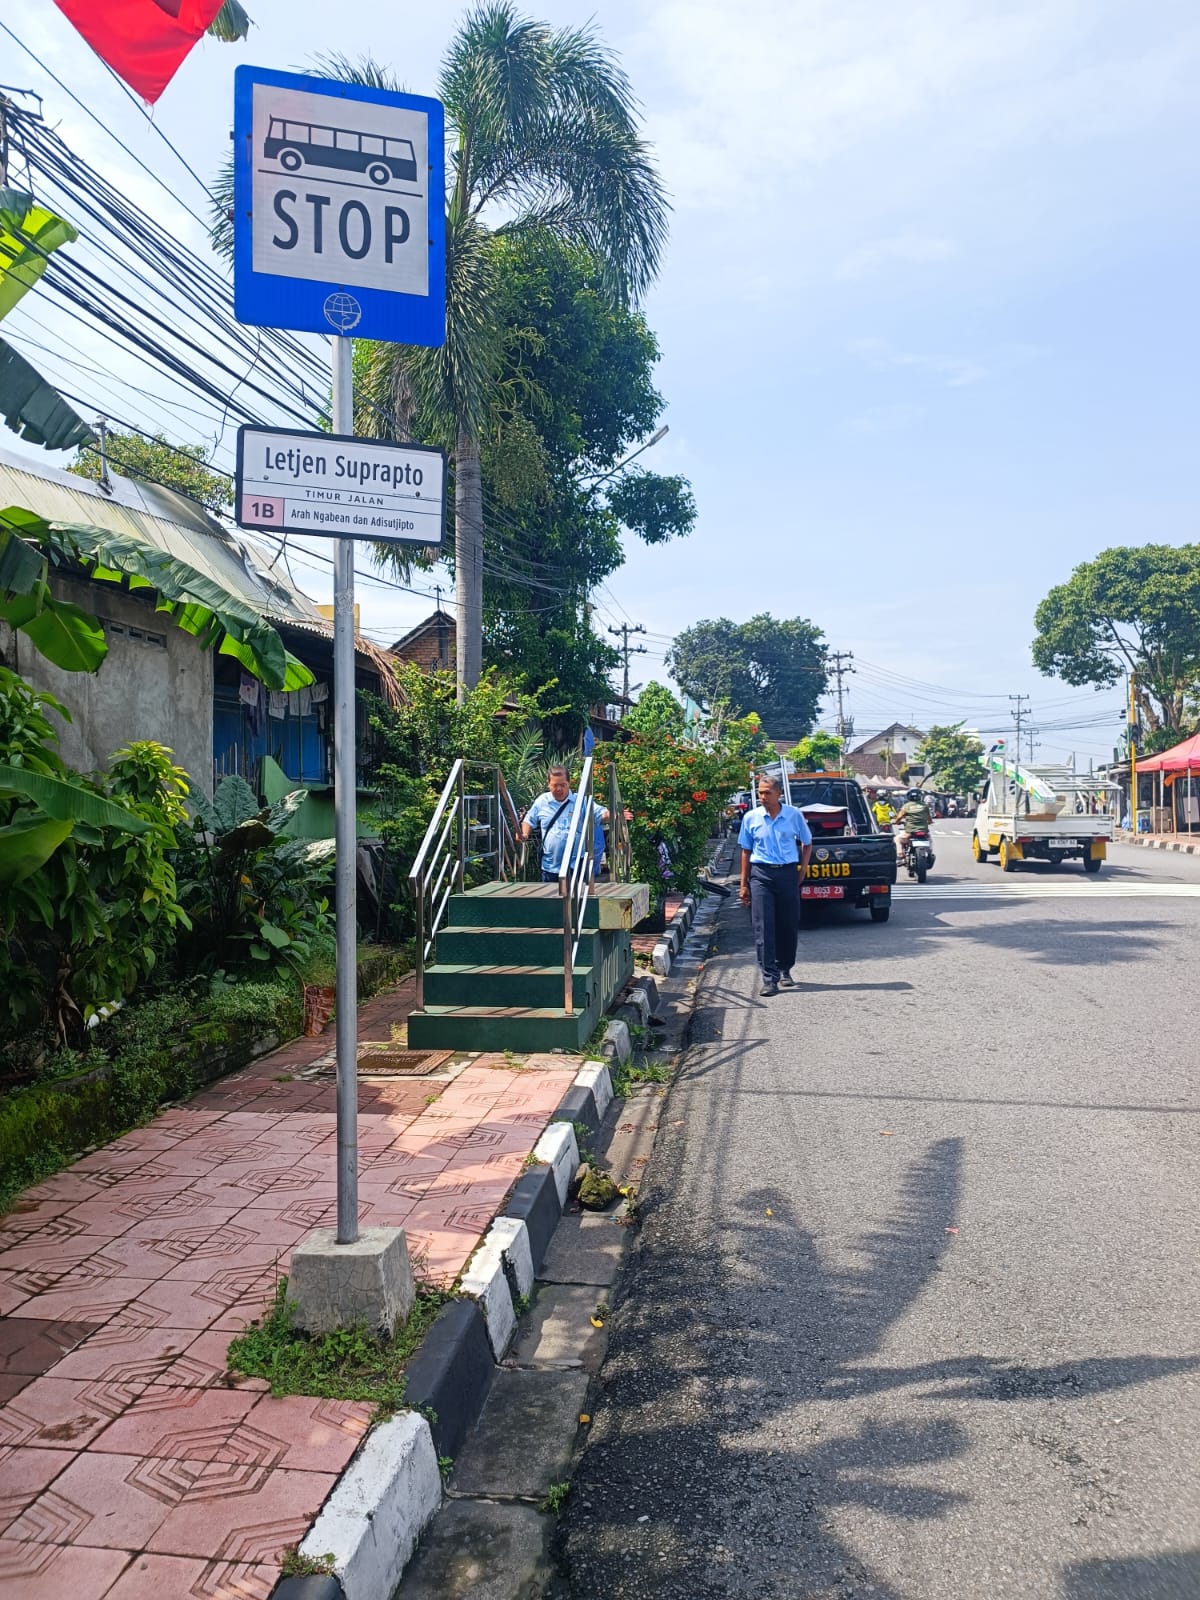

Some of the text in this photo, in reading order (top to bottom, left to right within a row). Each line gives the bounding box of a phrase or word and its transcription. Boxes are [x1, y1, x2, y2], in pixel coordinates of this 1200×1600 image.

[272, 189, 410, 264] STOP
[265, 446, 423, 489] Letjen Suprapto
[305, 489, 384, 505] TIMUR JALAN
[251, 502, 275, 519] 1B
[291, 508, 414, 531] Arah Ngabean dan Adisutjipto
[797, 862, 850, 878] ISHUB
